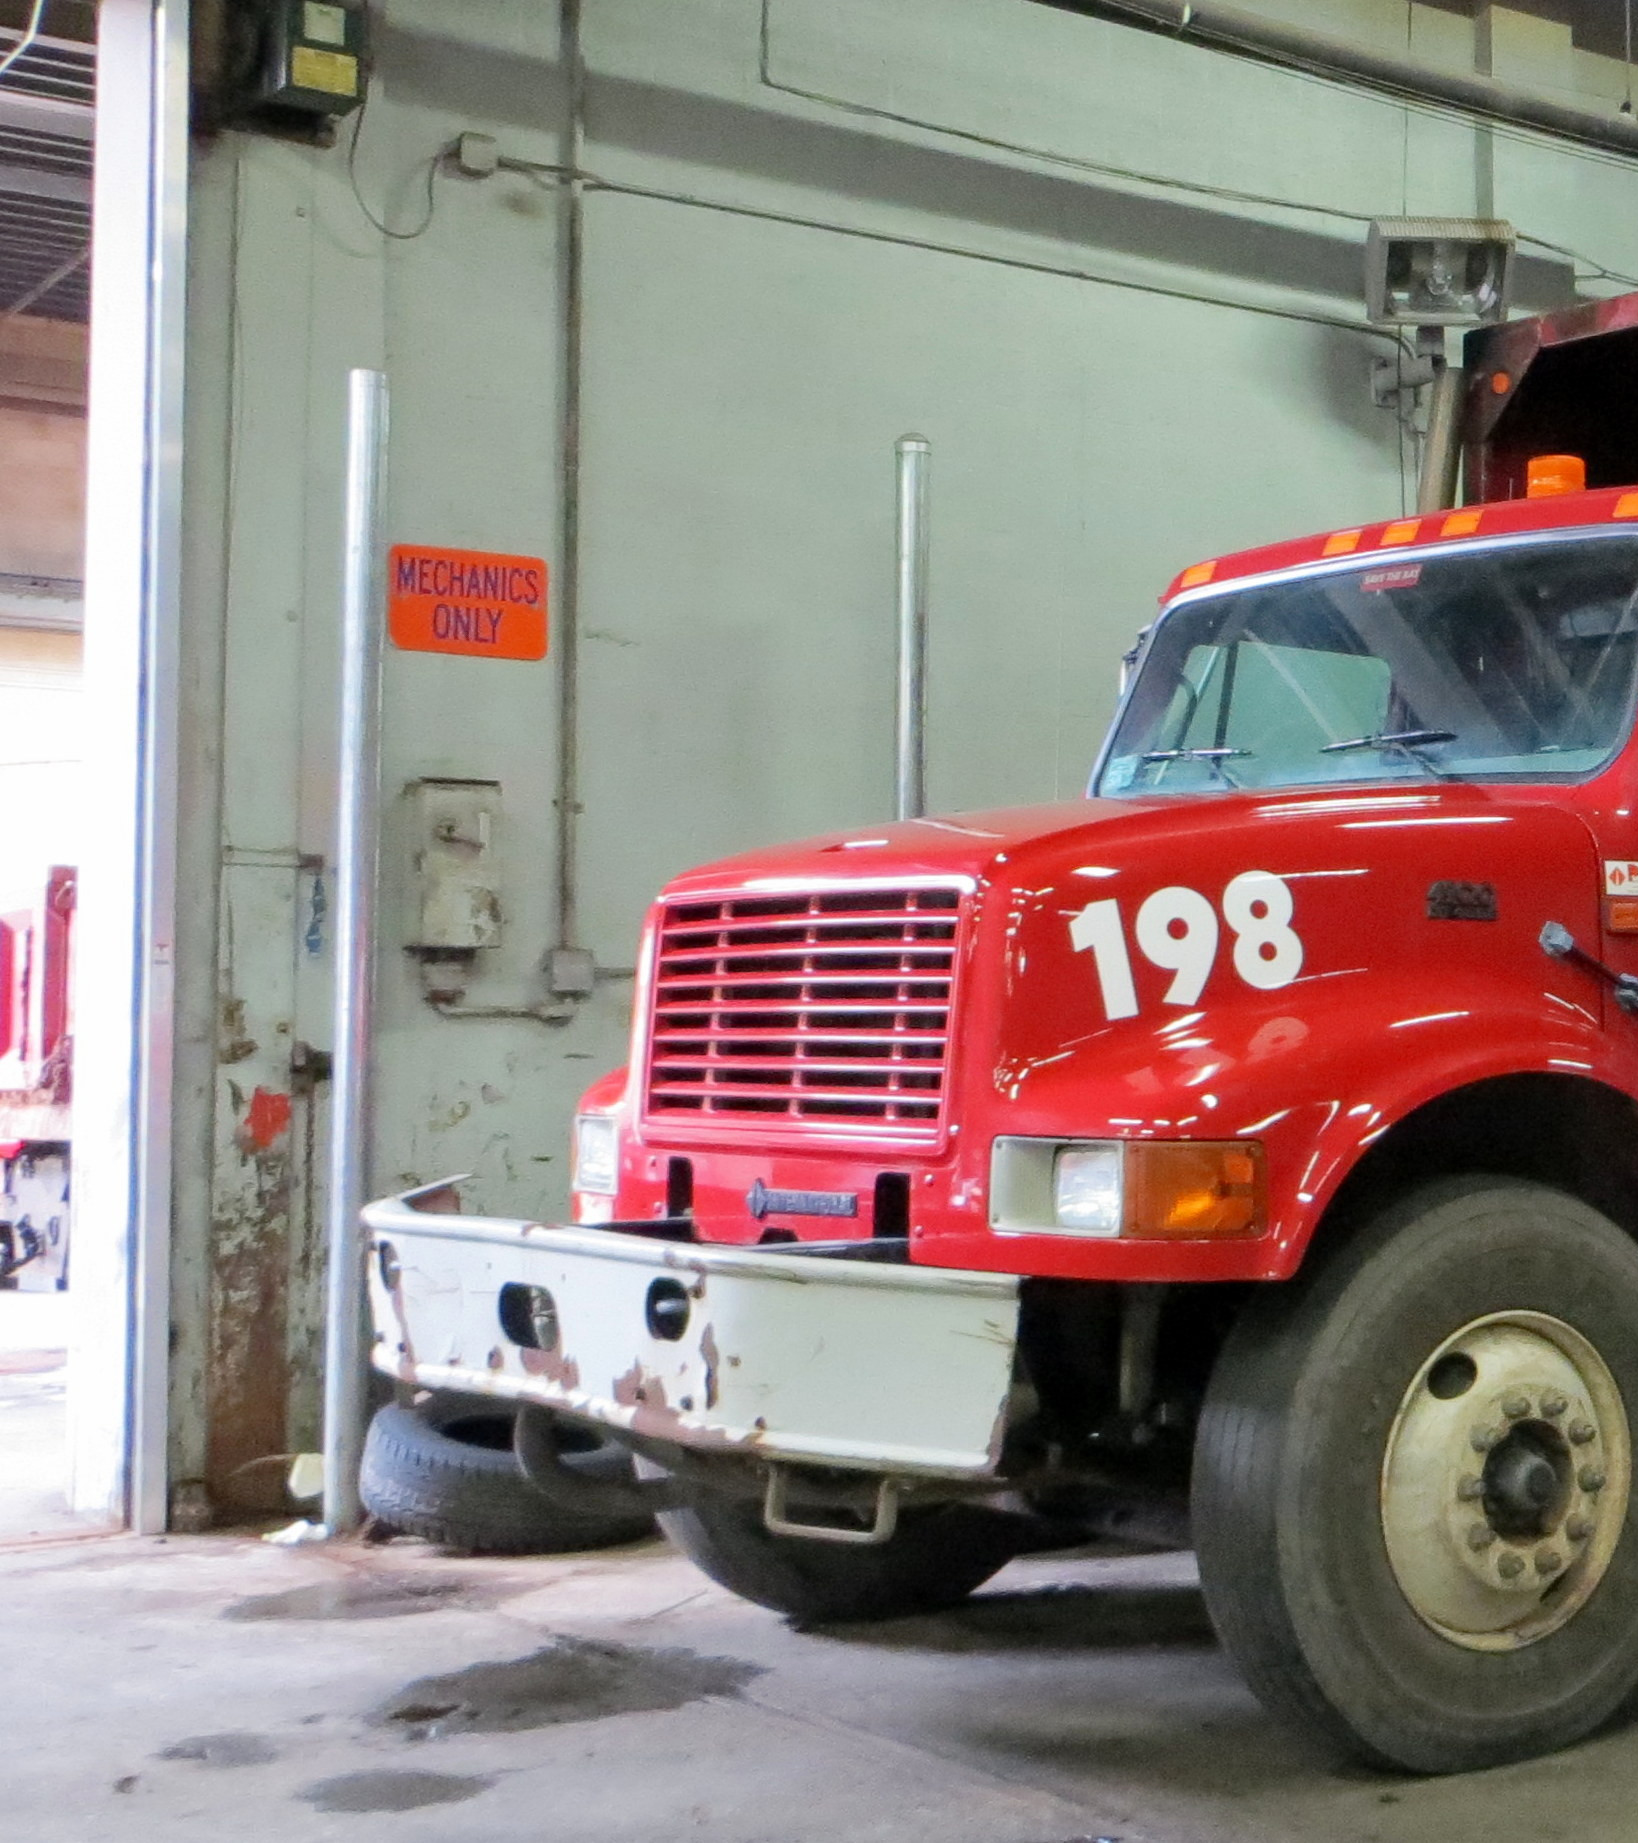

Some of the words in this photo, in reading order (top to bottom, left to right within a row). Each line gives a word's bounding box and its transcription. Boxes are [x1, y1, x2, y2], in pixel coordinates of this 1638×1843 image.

[397, 555, 540, 604] MECHANICS
[432, 603, 505, 644] ONLY
[1068, 870, 1304, 1021] 198
